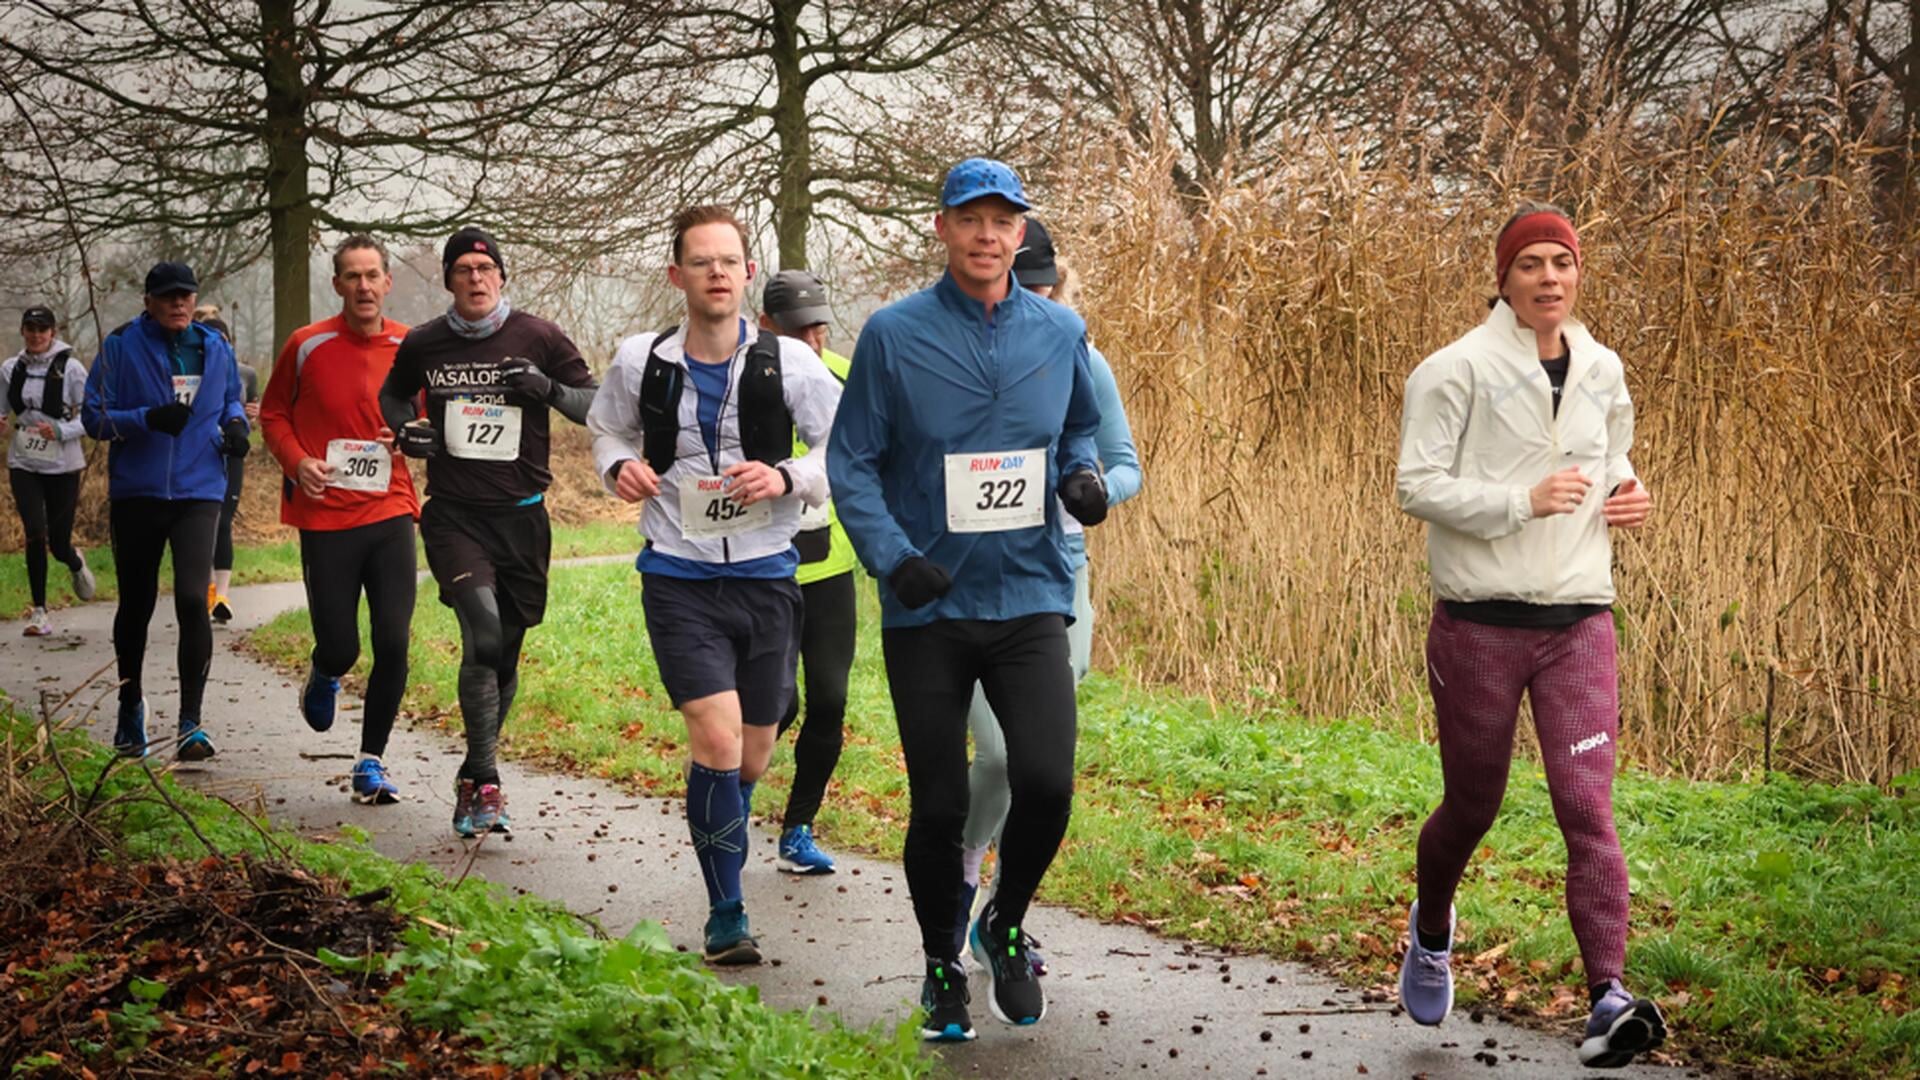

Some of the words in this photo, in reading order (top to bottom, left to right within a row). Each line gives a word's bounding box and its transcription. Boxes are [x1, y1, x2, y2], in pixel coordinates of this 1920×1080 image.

[25, 438, 48, 451] 313
[467, 422, 505, 445] 127
[344, 456, 379, 478] 306
[976, 478, 1027, 510] 322
[1570, 731, 1610, 756] HOKA
